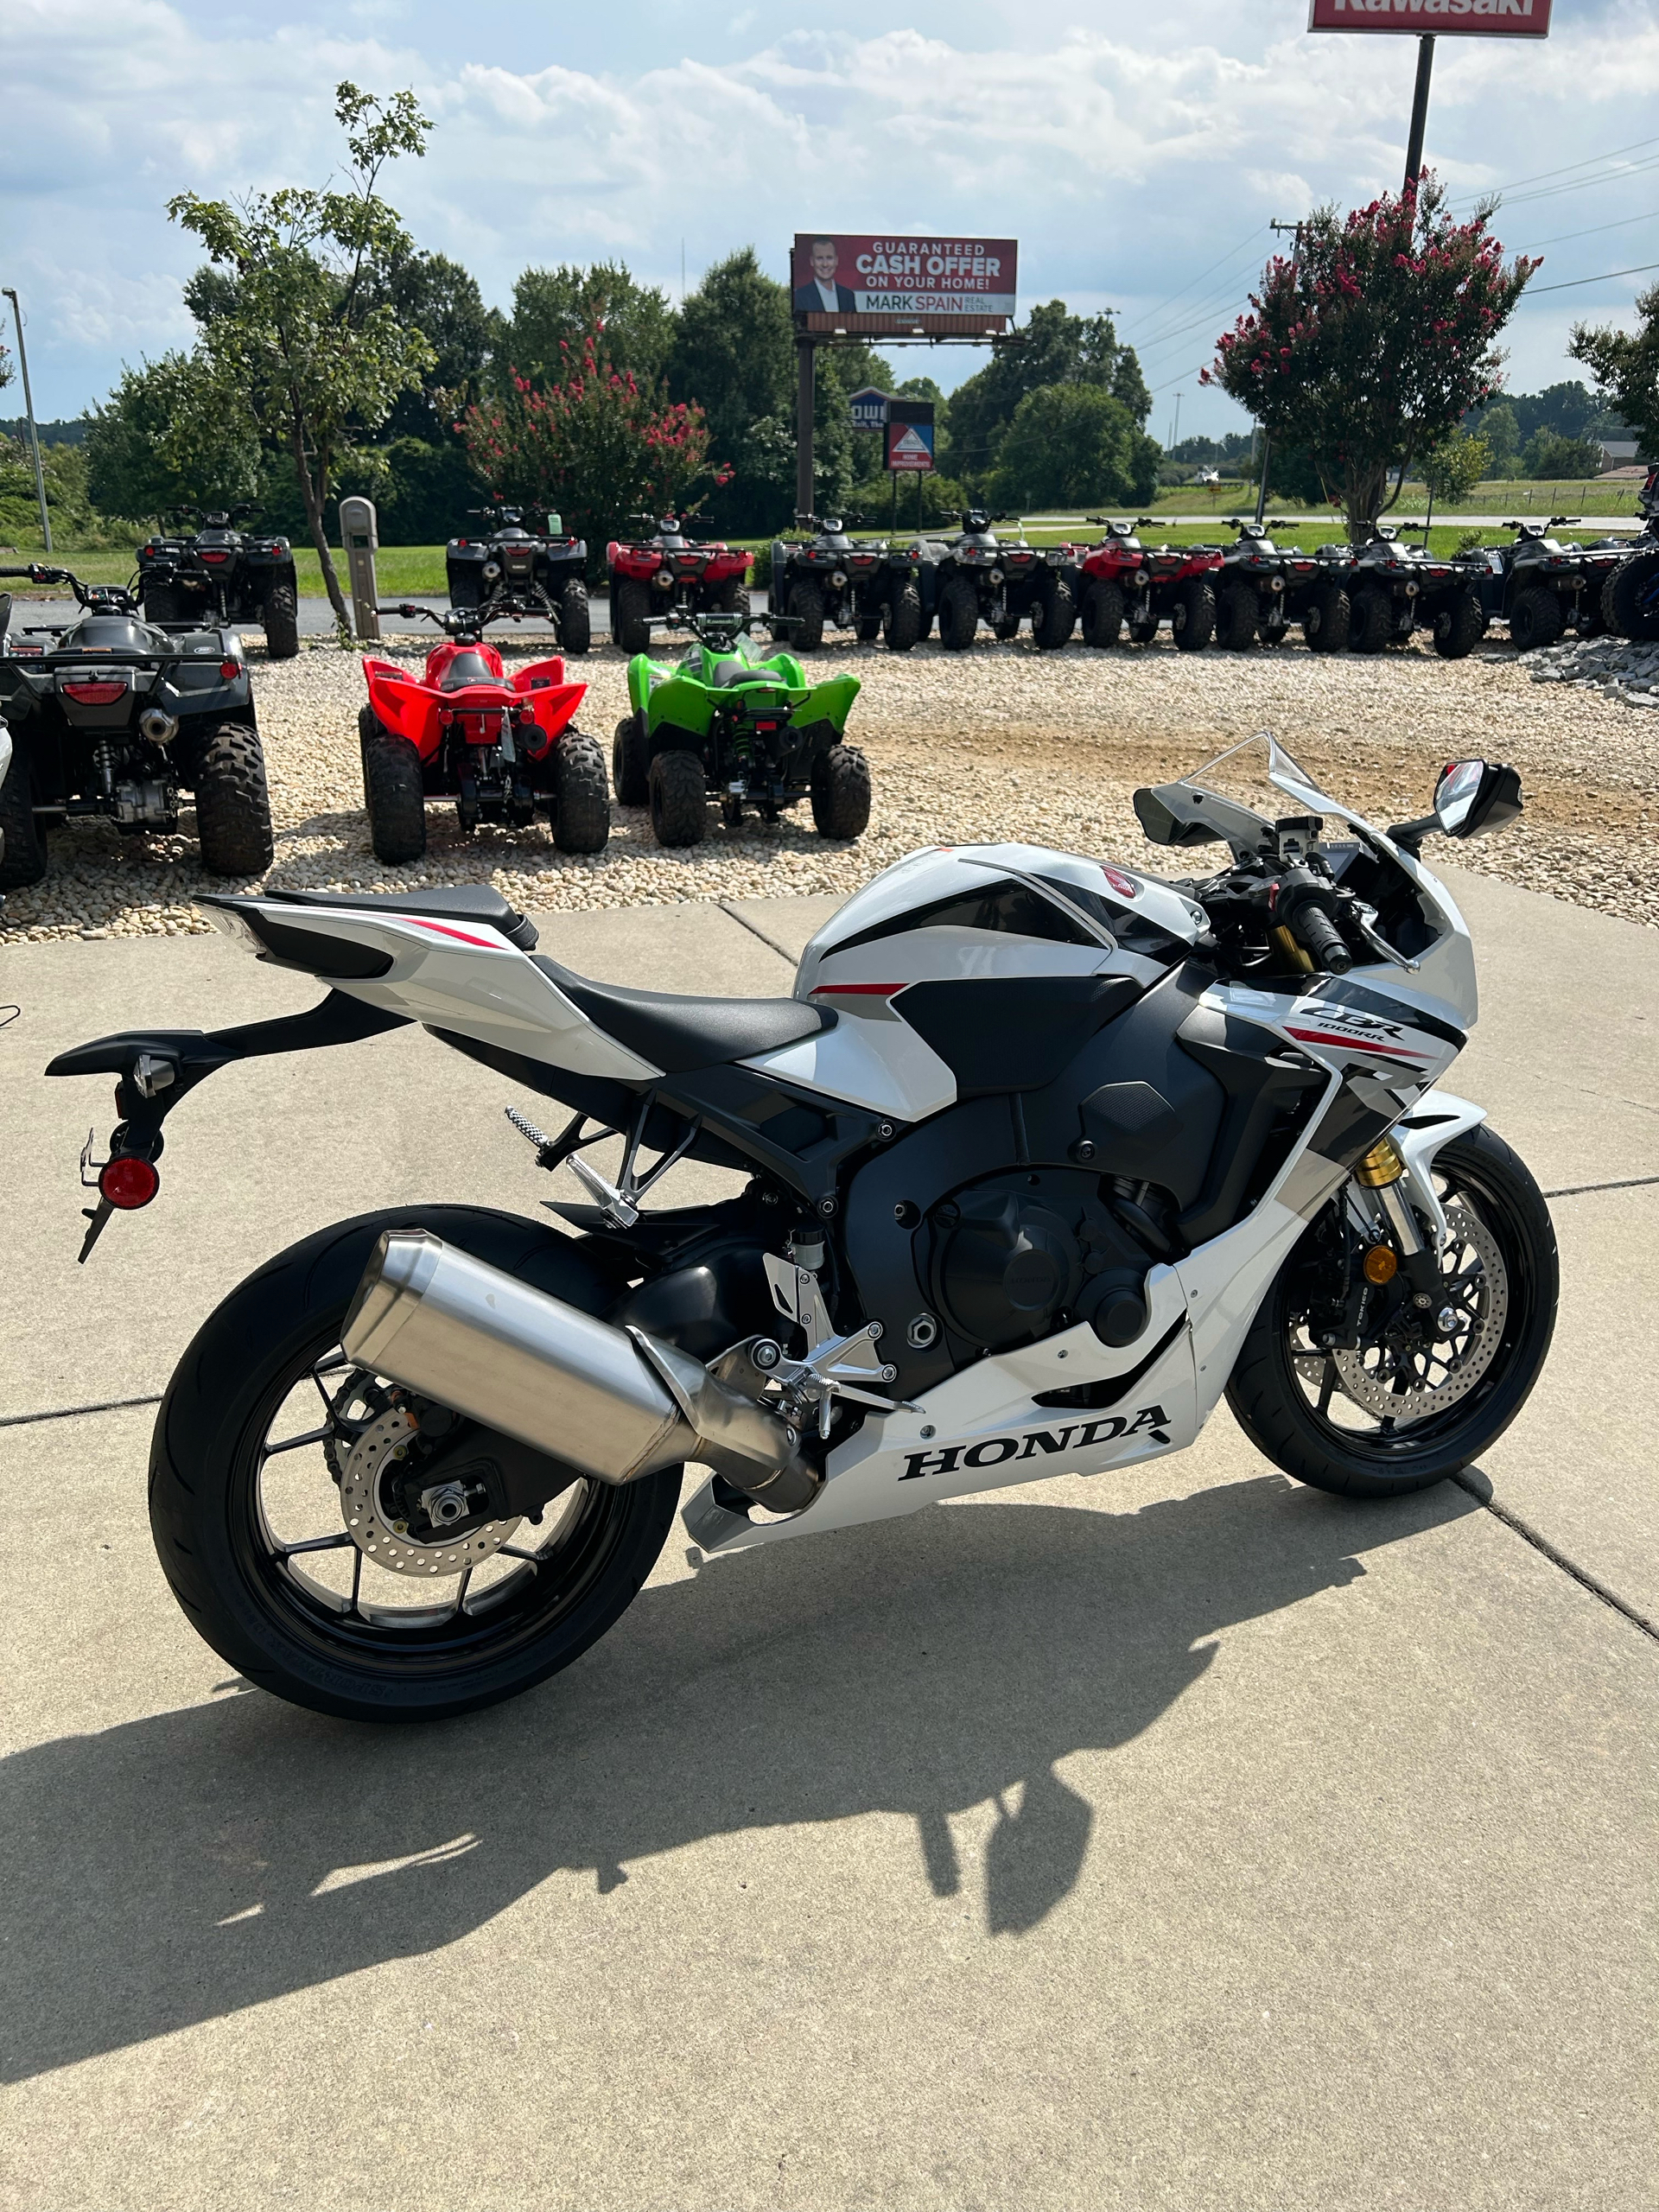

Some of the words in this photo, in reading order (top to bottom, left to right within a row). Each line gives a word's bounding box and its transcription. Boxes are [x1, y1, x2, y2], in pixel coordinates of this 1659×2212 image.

[873, 242, 985, 256] GUARANTEED
[855, 254, 921, 275] CASH
[926, 256, 1001, 276] OFFER
[866, 276, 888, 288] ON
[894, 276, 936, 289] YOUR
[941, 277, 990, 290] HOME!
[866, 295, 913, 311] MARK
[915, 296, 963, 312] SPAIN
[1299, 1007, 1405, 1041] CBR
[1318, 1022, 1385, 1042] 1000RR
[897, 1405, 1173, 1482] HONDA
